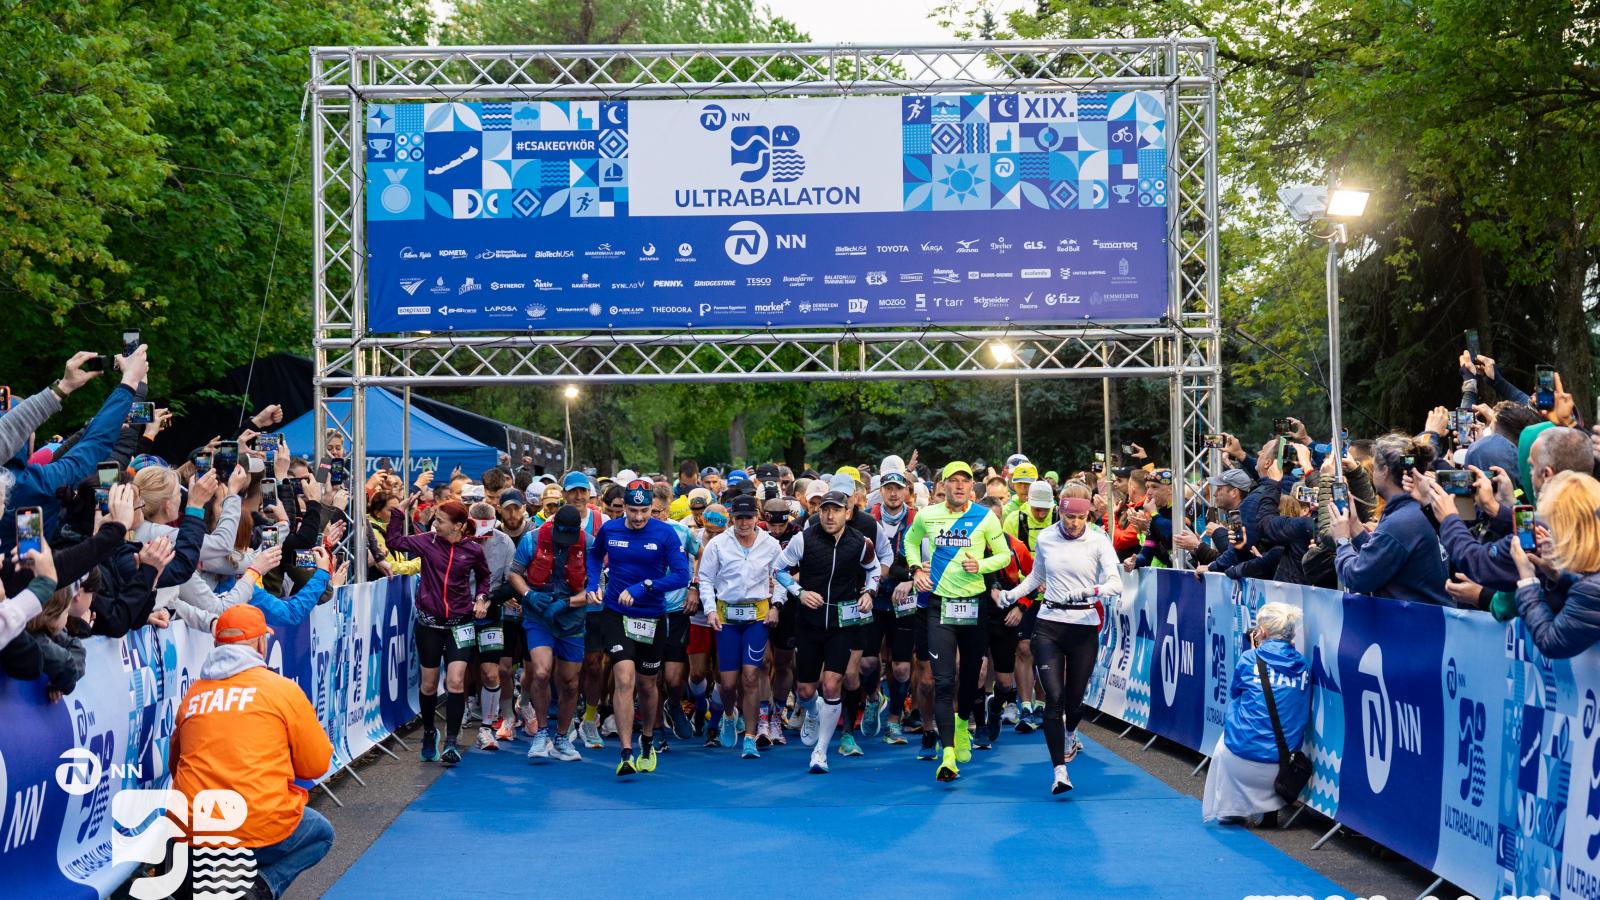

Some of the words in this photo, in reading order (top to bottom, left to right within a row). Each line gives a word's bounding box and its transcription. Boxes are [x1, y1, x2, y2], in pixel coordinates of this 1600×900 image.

[1024, 97, 1075, 118] XIX.
[732, 112, 750, 122] NN
[516, 138, 595, 152] #CSAKEGYKÖR
[675, 186, 860, 208] ULTRABALATON
[776, 234, 806, 249] NN
[920, 241, 943, 252] VARGA
[945, 298, 964, 306] tarr
[1058, 293, 1080, 303] fizz
[634, 622, 646, 630] 184
[1182, 640, 1194, 676] NN
[185, 687, 257, 718] STAFF
[1395, 700, 1421, 755] NN
[4, 782, 46, 853] NN
[1445, 804, 1494, 848] ULTRABALATON
